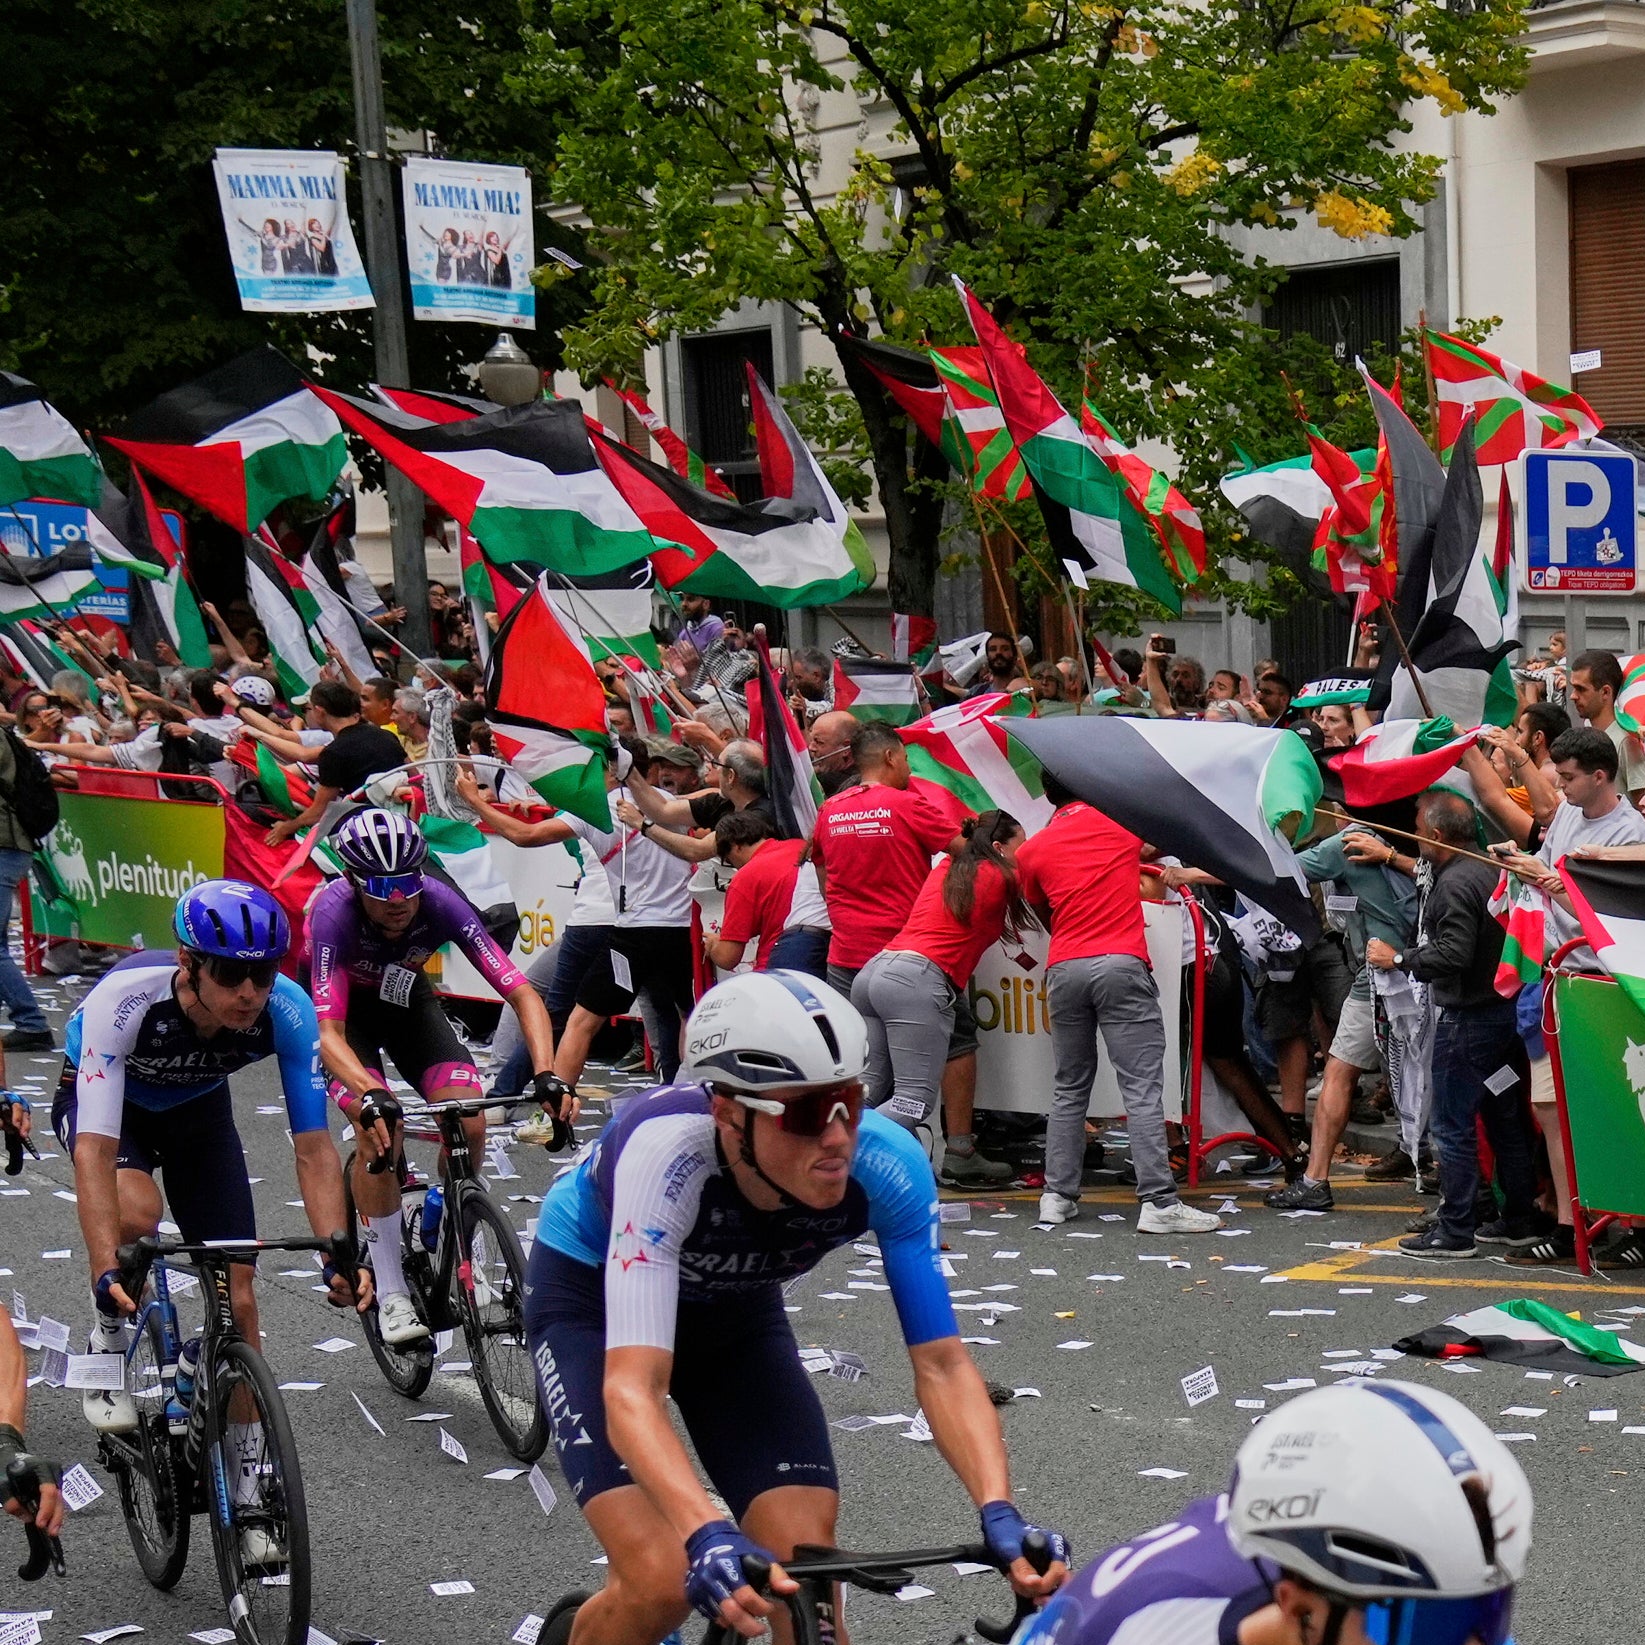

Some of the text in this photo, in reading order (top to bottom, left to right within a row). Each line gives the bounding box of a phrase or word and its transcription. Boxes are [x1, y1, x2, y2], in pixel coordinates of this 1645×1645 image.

[226, 174, 297, 199] MAMMA
[414, 183, 521, 215] MAMMA MIA!
[1335, 342, 1346, 358] 62
[1547, 460, 1613, 563] P
[79, 595, 127, 607] TERÍAS
[828, 807, 891, 823] ORGANIZACIÓN
[474, 937, 501, 969] CORTIZO
[113, 992, 149, 1031] FANTINI
[451, 1147, 469, 1156] BH
[214, 1270, 232, 1327] FACTOR
[536, 1339, 566, 1418] ISRAEL
